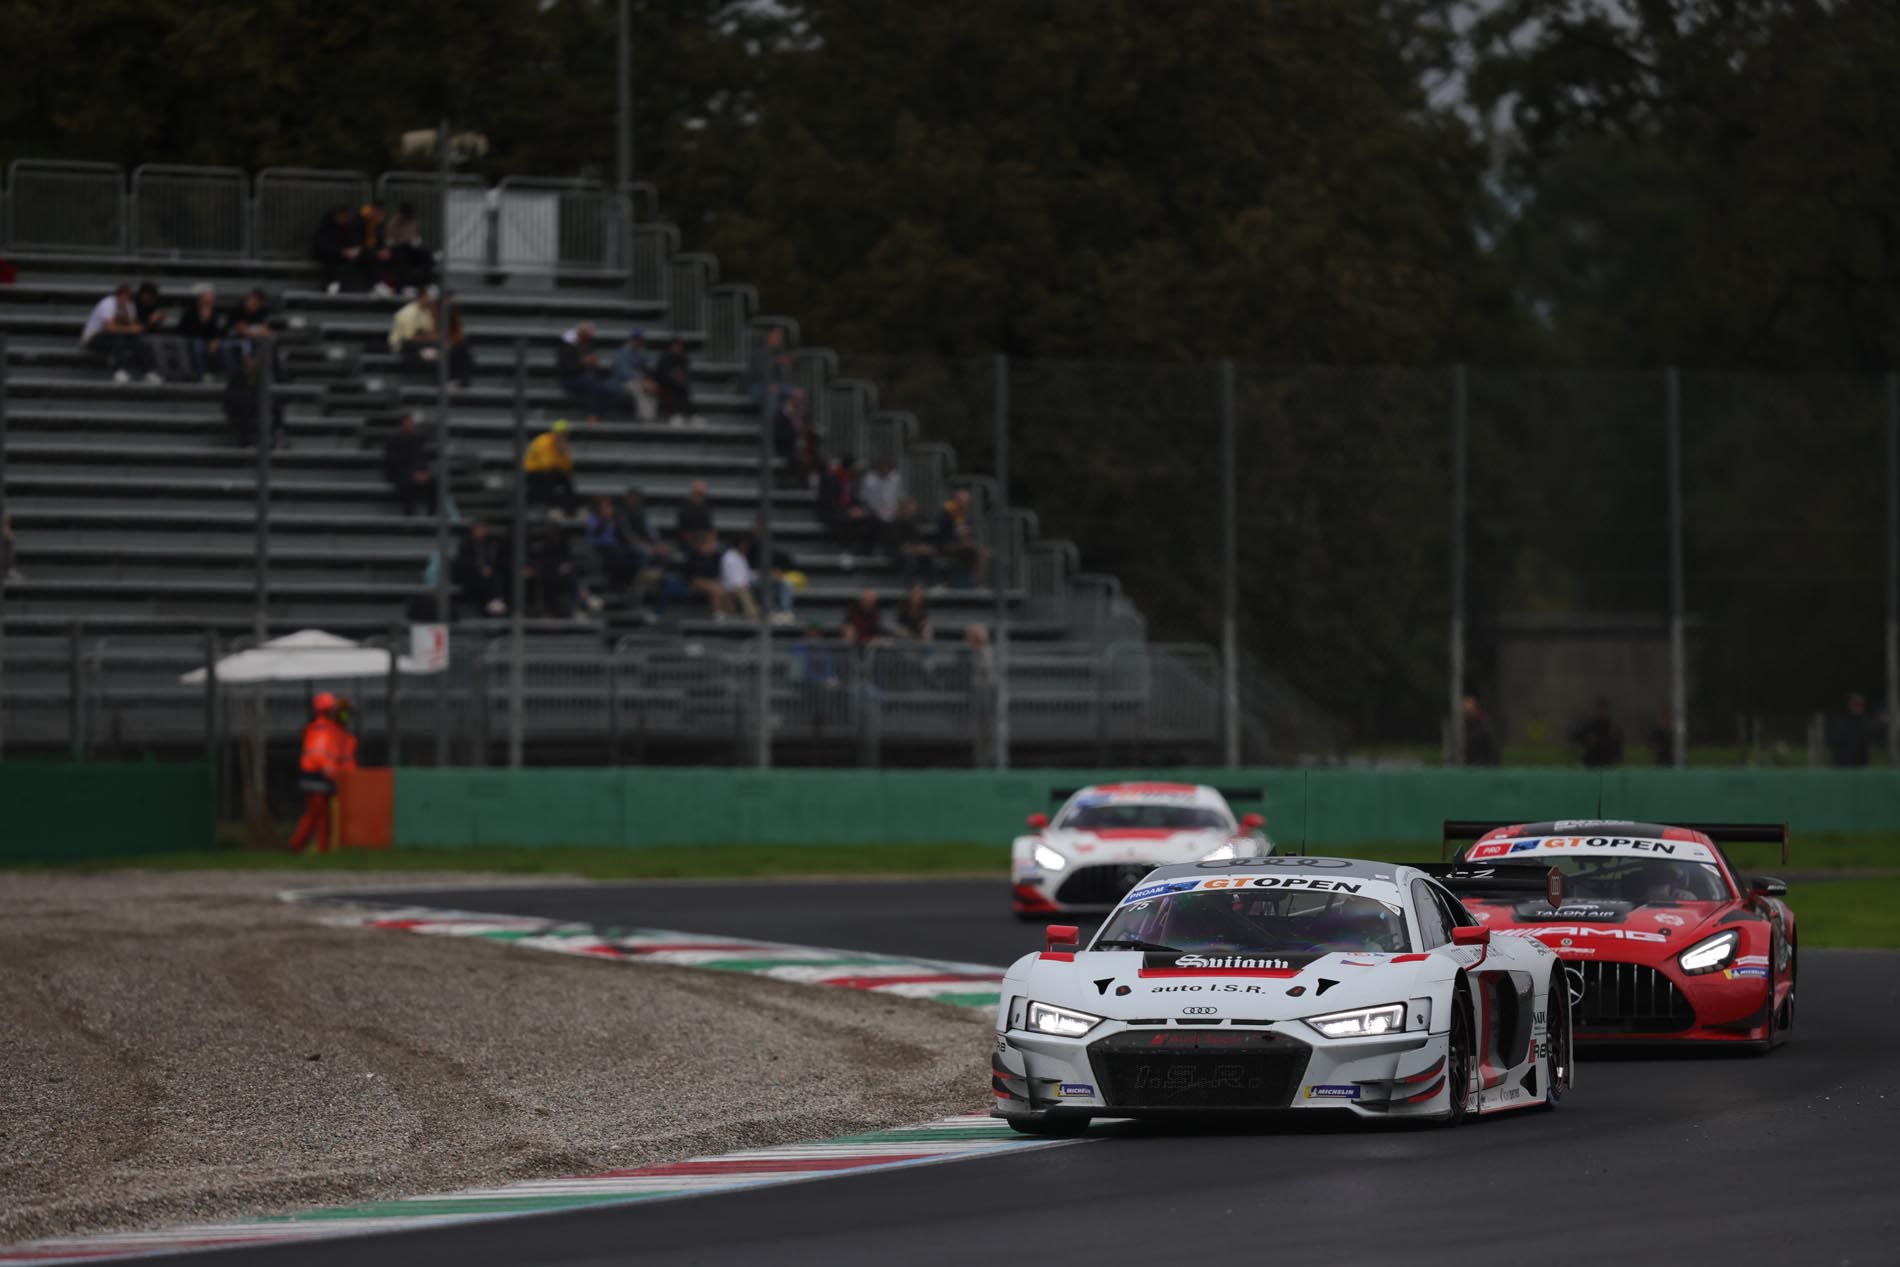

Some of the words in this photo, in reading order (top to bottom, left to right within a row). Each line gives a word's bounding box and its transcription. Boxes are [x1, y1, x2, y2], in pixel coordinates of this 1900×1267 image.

[1482, 846, 1502, 855] PRO
[1128, 886, 1165, 901] PROAM
[1128, 901, 1150, 912] 75
[1151, 984, 1203, 993] auto
[1210, 984, 1267, 994] I.S.R.
